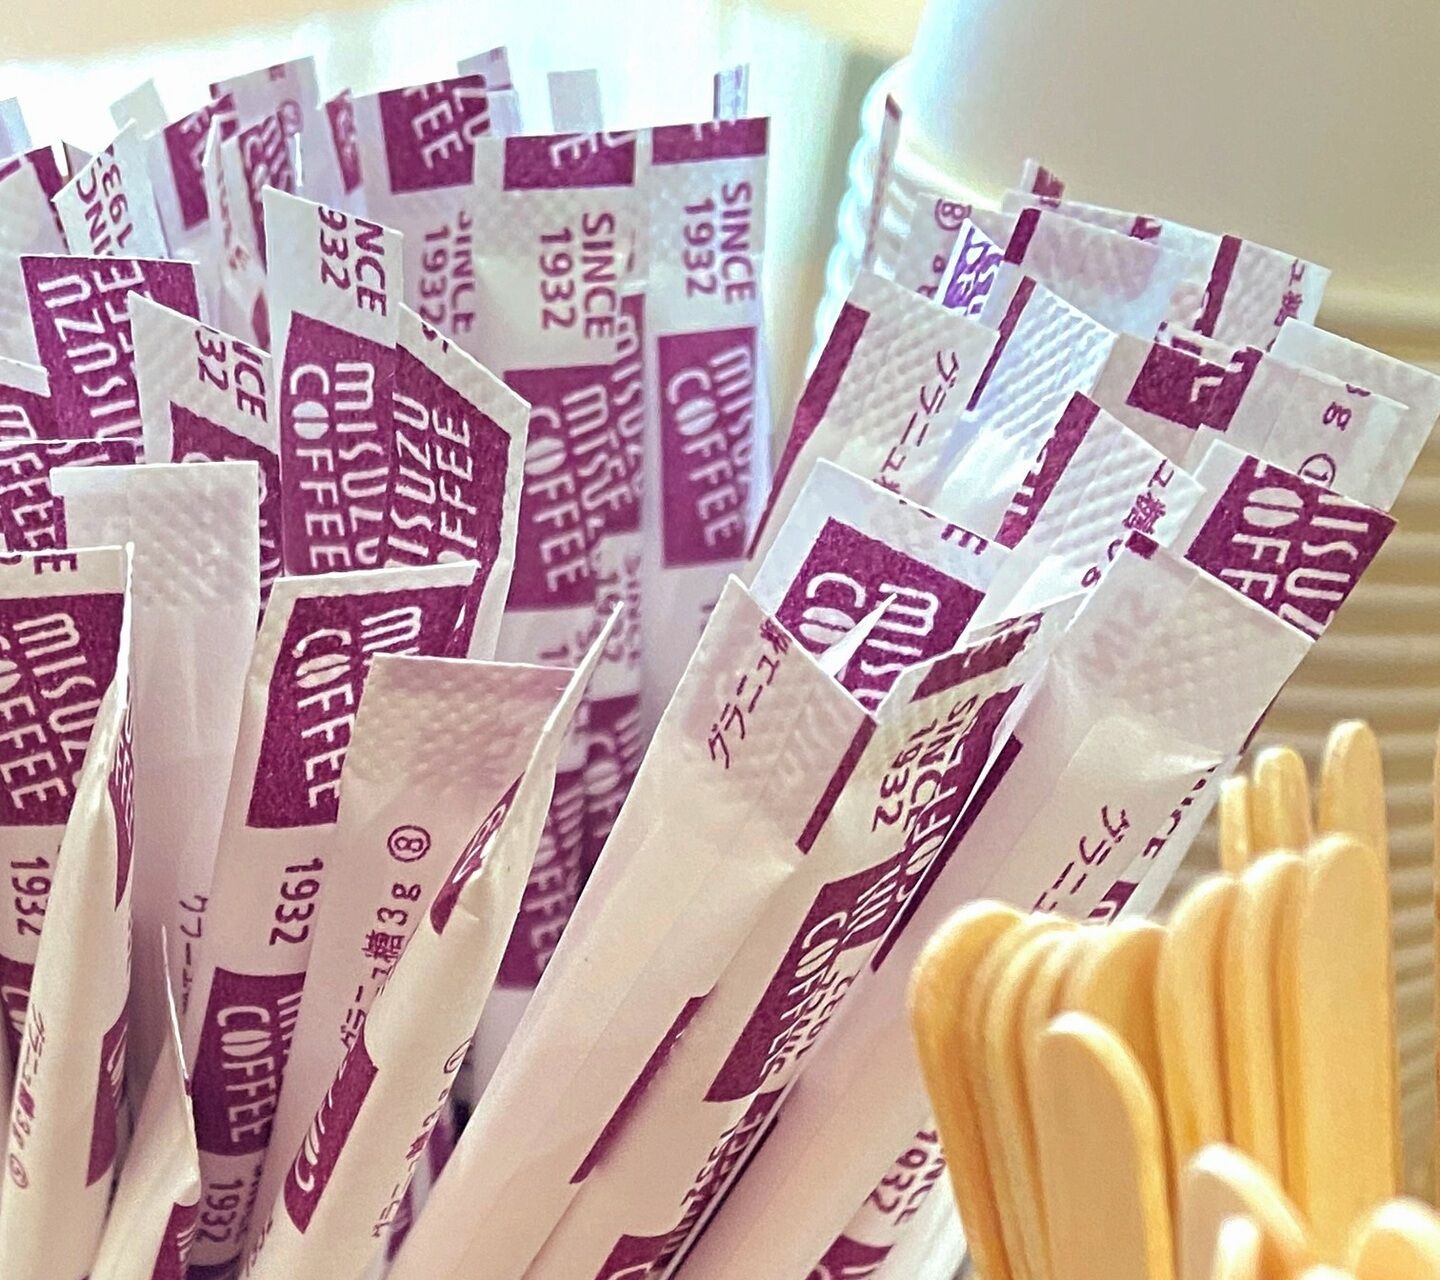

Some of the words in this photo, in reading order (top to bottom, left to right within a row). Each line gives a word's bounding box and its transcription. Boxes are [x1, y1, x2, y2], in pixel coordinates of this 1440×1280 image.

[353, 218, 387, 317] NCE
[539, 226, 577, 330] 1932
[581, 212, 618, 340] SINCE
[683, 197, 718, 298] 1932
[721, 181, 756, 304] SINCE
[37, 274, 144, 438] ISUZU
[290, 364, 351, 569] COFFEE
[387, 391, 437, 567] ISUZU
[667, 365, 746, 547] COFFEE
[295, 628, 355, 808] COFFEE
[871, 716, 939, 833] 1932
[268, 857, 325, 946] 1932
[216, 1005, 276, 1144] COFFEE
